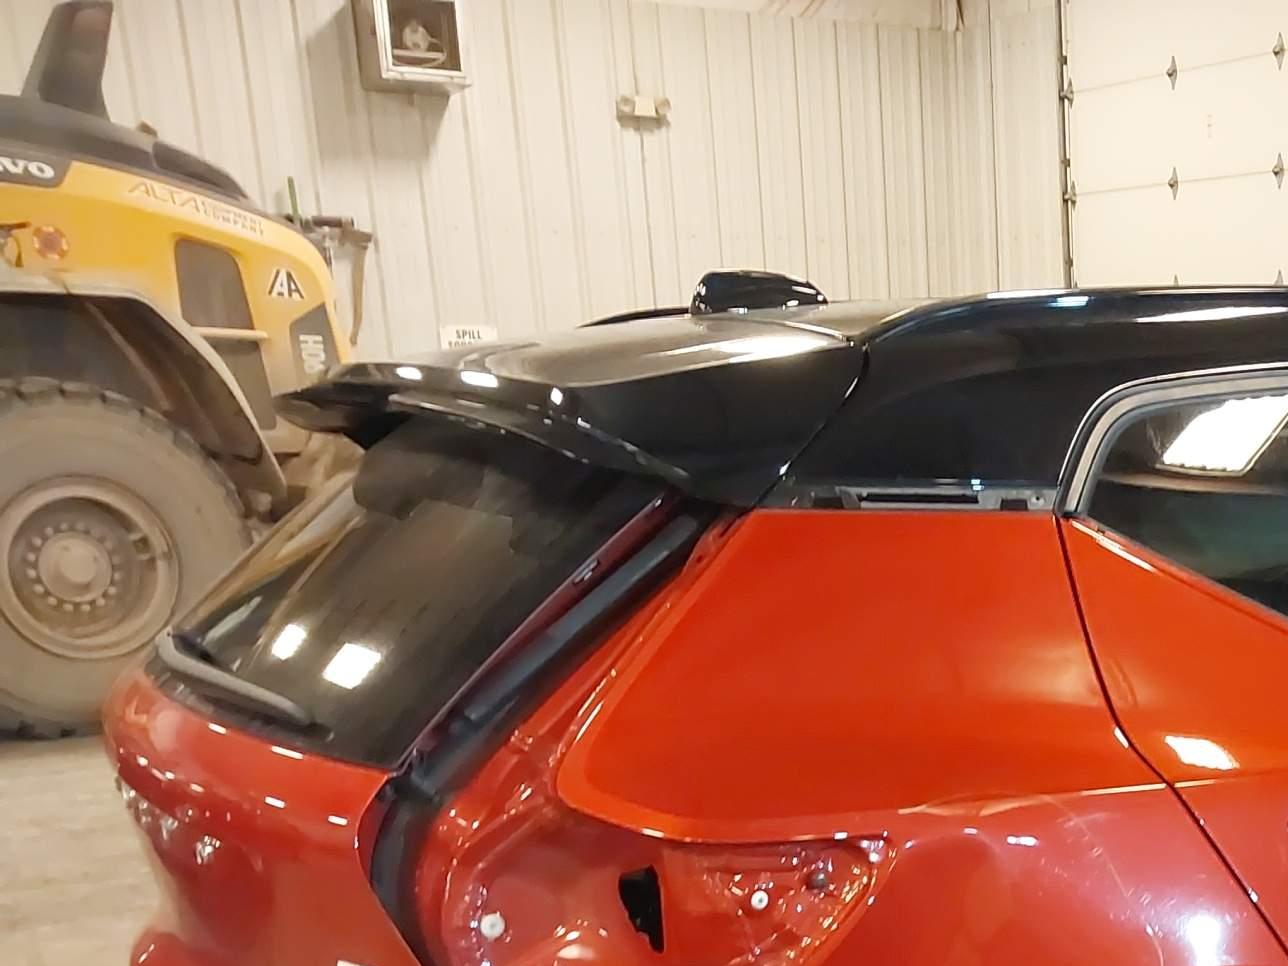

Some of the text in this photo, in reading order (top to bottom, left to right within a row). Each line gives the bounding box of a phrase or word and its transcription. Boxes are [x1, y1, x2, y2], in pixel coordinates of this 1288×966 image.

[0, 156, 55, 178] VO
[127, 181, 201, 213] ALTA
[455, 329, 482, 340] SPILL
